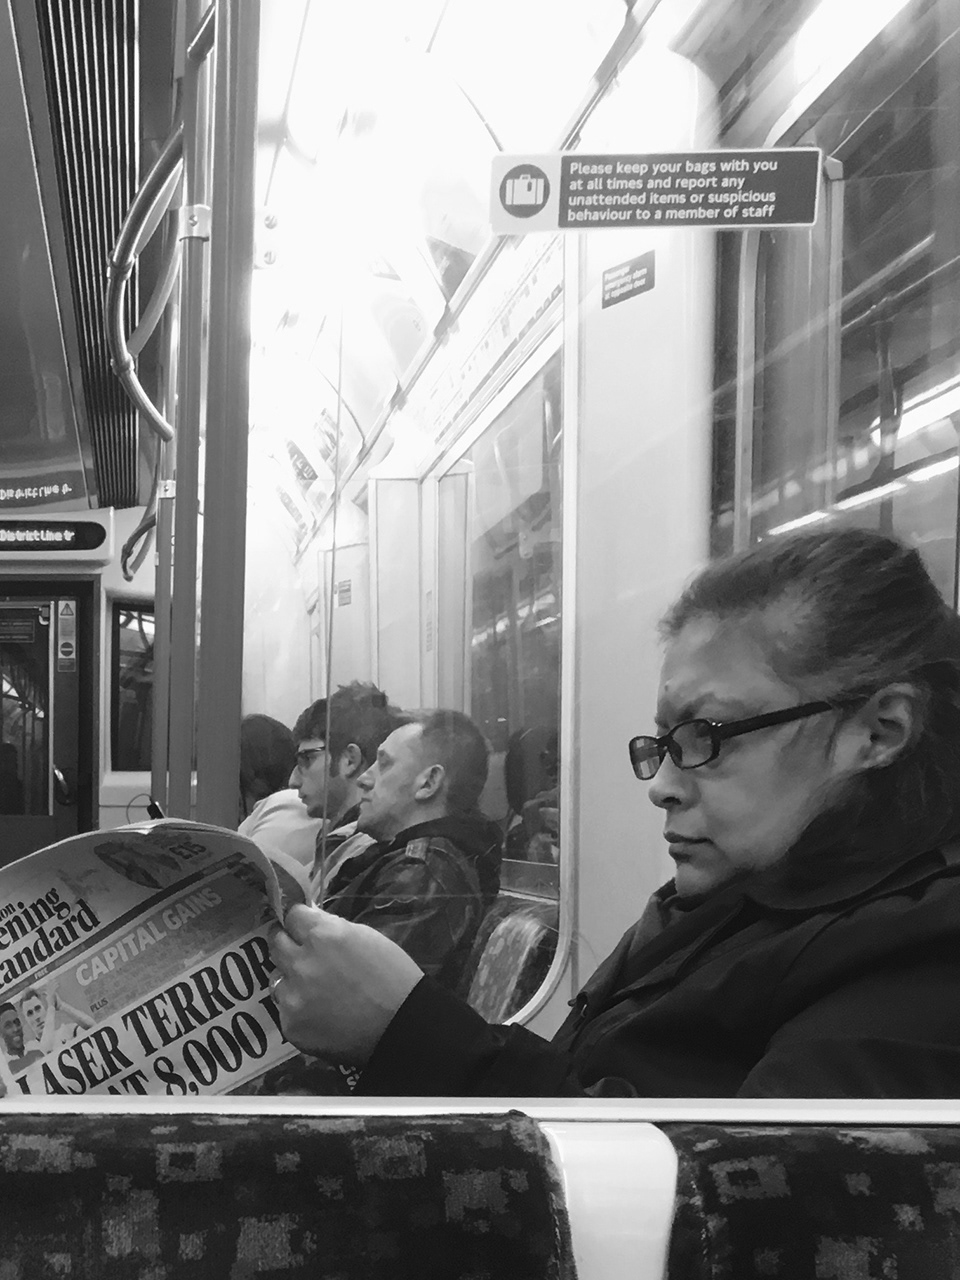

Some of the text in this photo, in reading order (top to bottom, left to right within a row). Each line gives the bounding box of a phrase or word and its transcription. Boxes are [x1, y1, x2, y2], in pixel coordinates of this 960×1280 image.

[569, 159, 778, 176] Please keep your bags with you
[569, 176, 745, 190] at all times and report any
[568, 190, 776, 206] unattended items or suspicious
[567, 204, 775, 221] behaviour to a member of staff
[0, 528, 40, 542] District
[40, 529, 63, 542] Line
[75, 920, 167, 986] CAPITAL
[162, 887, 223, 930] GAINS
[89, 997, 108, 1013] PLUS
[121, 936, 277, 1057] TERROR
[153, 1011, 268, 1096] 8,000
